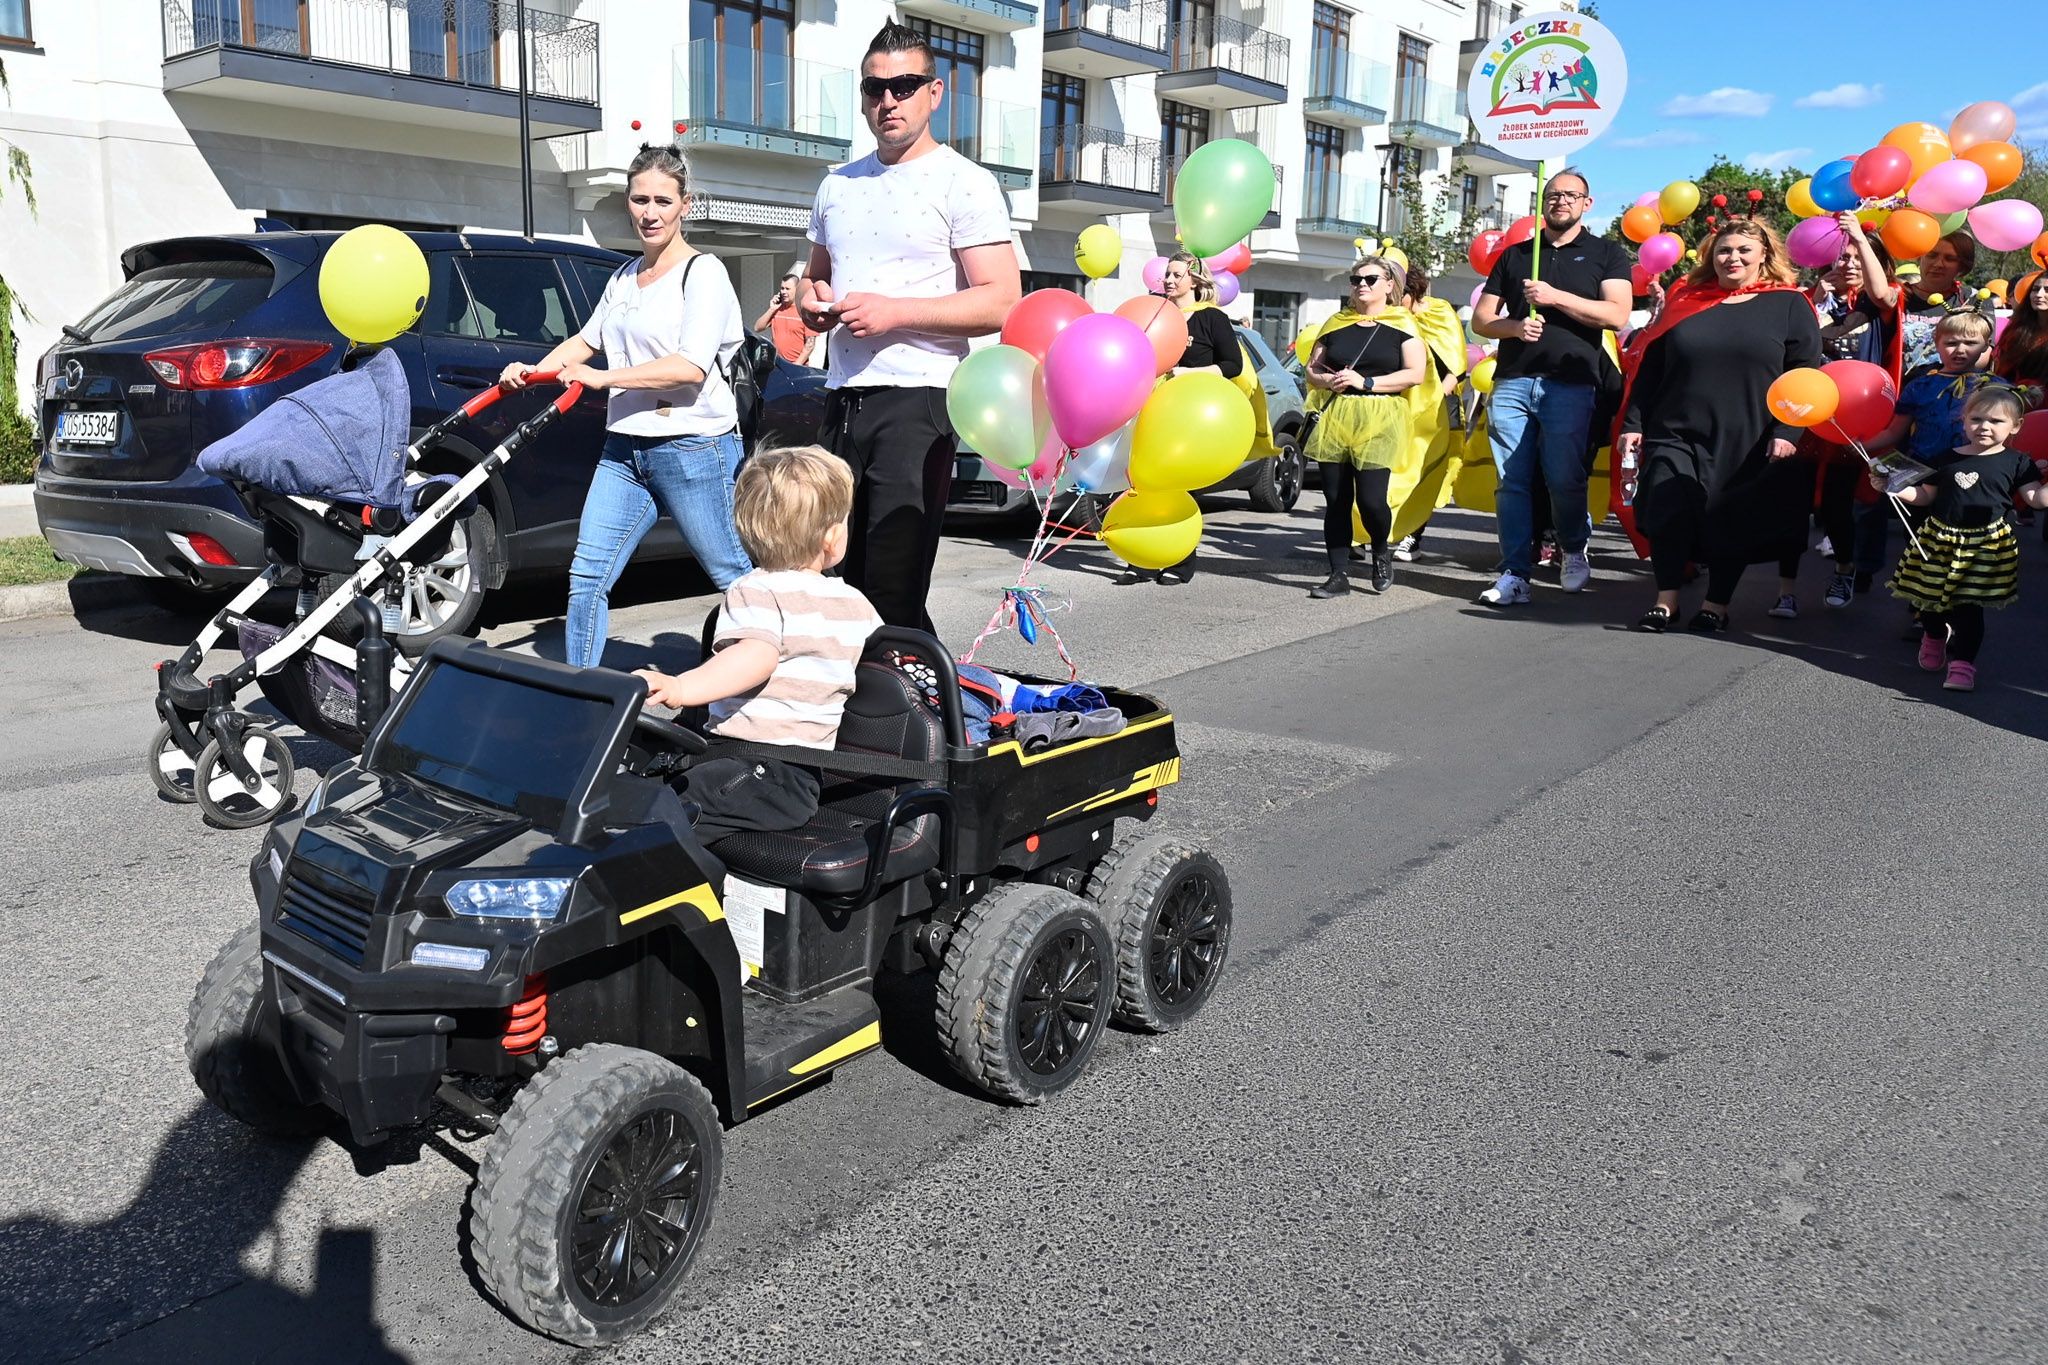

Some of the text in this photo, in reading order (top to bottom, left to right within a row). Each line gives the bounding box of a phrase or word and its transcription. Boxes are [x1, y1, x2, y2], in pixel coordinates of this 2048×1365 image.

[1481, 20, 1582, 77] BAJECZKA
[1498, 128, 1589, 141] BAJECZKA W CIECHOCINKU
[1502, 119, 1584, 132] ŻŁOBEK SAMORZĄDOWY
[81, 414, 115, 437] 55384
